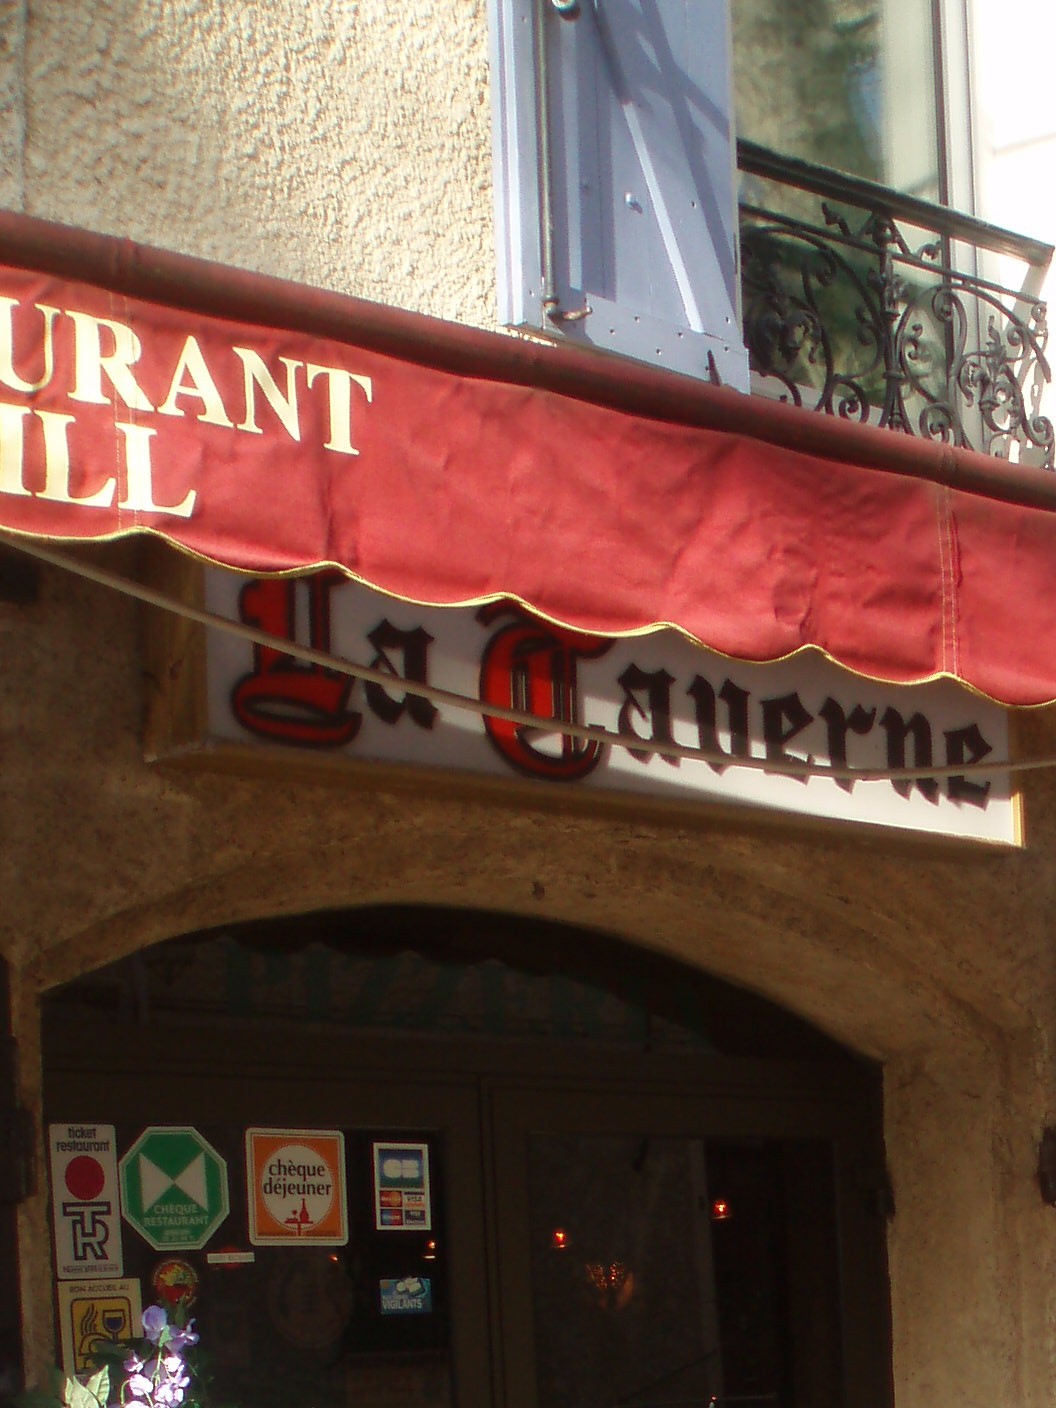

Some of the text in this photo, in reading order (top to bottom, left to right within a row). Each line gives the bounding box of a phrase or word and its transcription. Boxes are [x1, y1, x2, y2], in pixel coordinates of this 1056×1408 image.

[0, 296, 373, 456] URANT
[67, 1127, 97, 1140] ticket
[55, 1139, 111, 1152] restaurant
[268, 1159, 326, 1182] chèque
[263, 1177, 332, 1199] déjeuner
[143, 1216, 209, 1226] RESTAURANT
